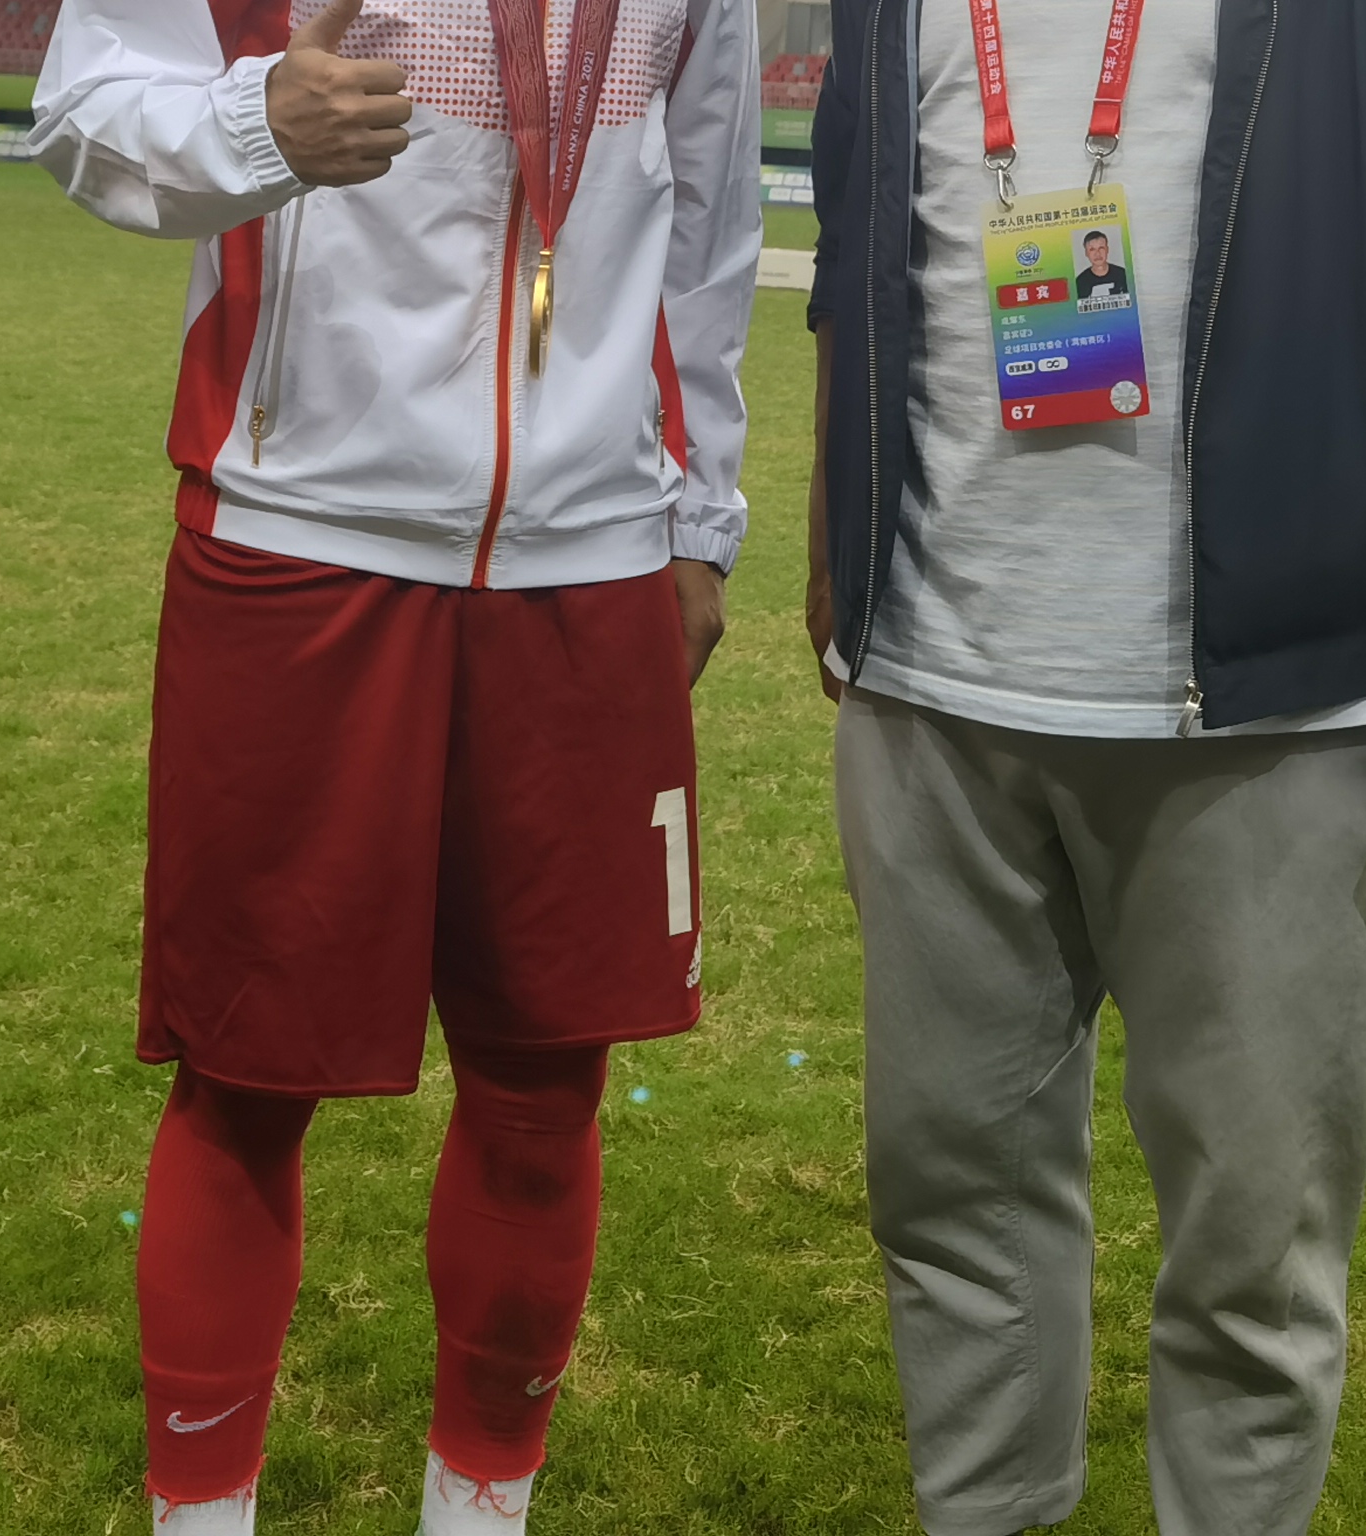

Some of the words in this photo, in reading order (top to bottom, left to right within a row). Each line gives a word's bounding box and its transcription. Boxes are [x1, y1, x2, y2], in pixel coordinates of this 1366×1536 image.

[562, 128, 579, 192] SHAANXI
[574, 84, 590, 125] CHINA
[582, 51, 596, 81] 2021
[988, 202, 1118, 229] 中华人民共和国第十四届运动会
[1016, 285, 1050, 302] 嘉宾
[1011, 404, 1036, 420] 67
[651, 786, 692, 936] 1
